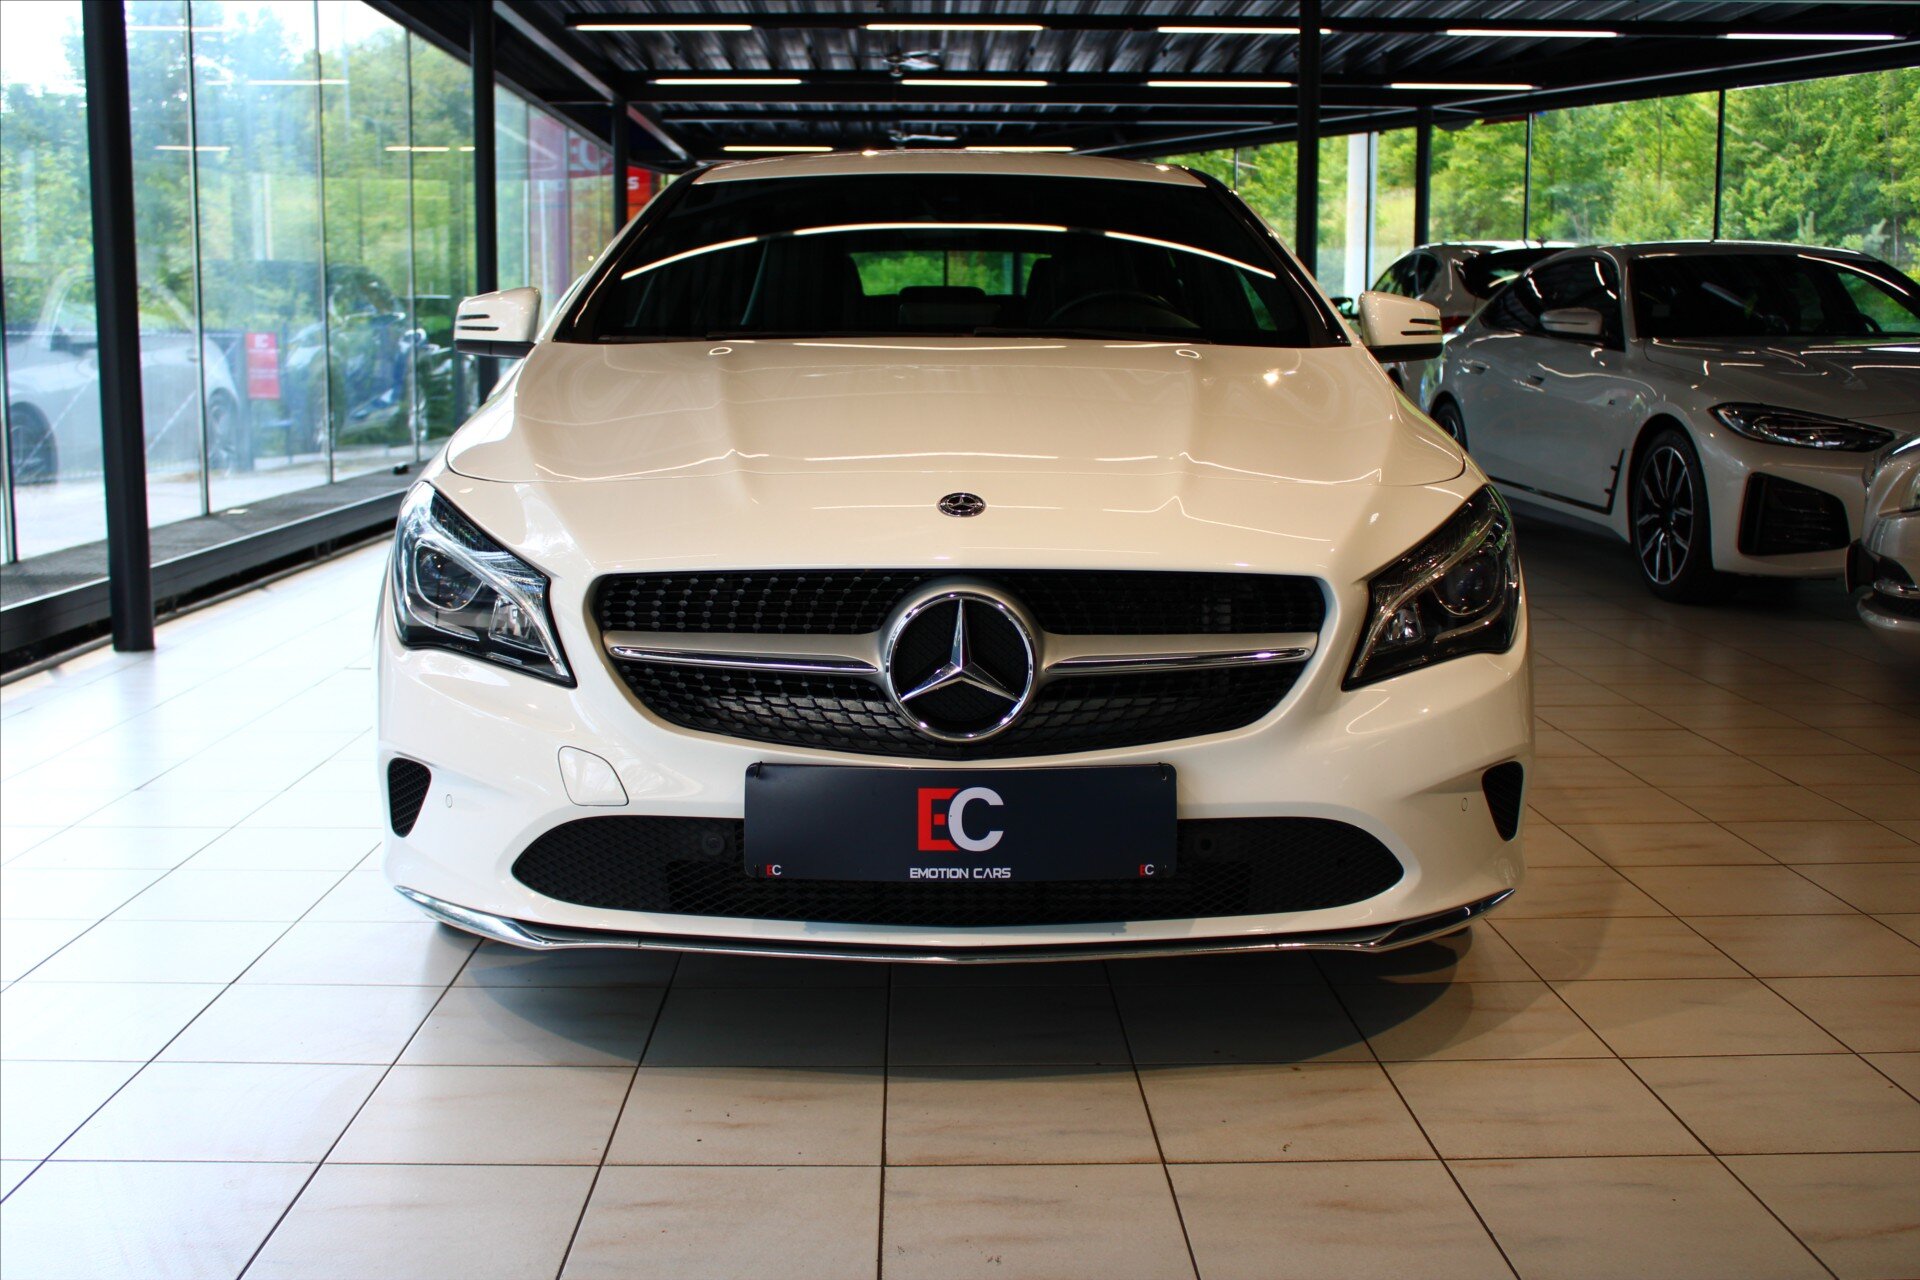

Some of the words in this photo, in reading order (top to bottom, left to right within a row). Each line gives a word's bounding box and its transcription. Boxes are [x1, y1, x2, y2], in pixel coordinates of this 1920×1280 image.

[917, 786, 1004, 852] EC
[765, 864, 782, 877] EC
[909, 867, 969, 879] EMOTION
[973, 867, 1012, 879] CARS
[1138, 863, 1155, 877] EC
